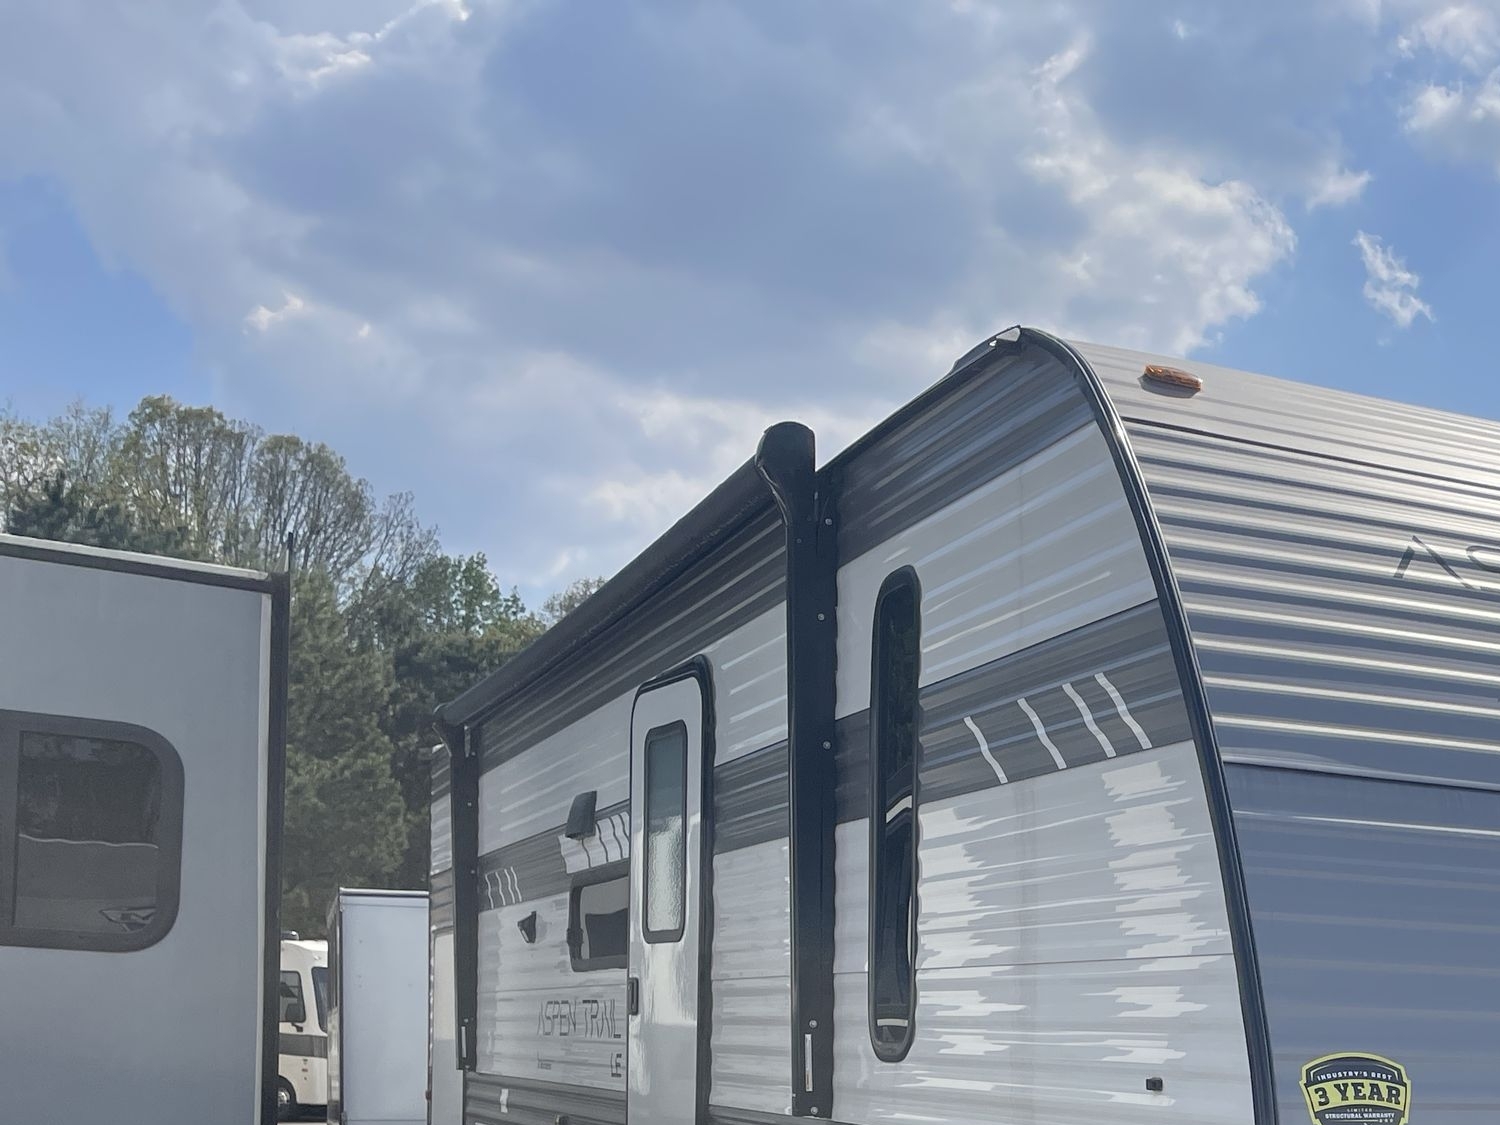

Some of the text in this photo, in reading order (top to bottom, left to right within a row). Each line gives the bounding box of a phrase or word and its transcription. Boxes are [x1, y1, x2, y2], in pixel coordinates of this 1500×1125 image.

[537, 999, 622, 1039] ASPEN TRAIL
[1317, 1071, 1393, 1081] INDUSTRY'S BEST
[1314, 1082, 1401, 1107] 3 YEAR
